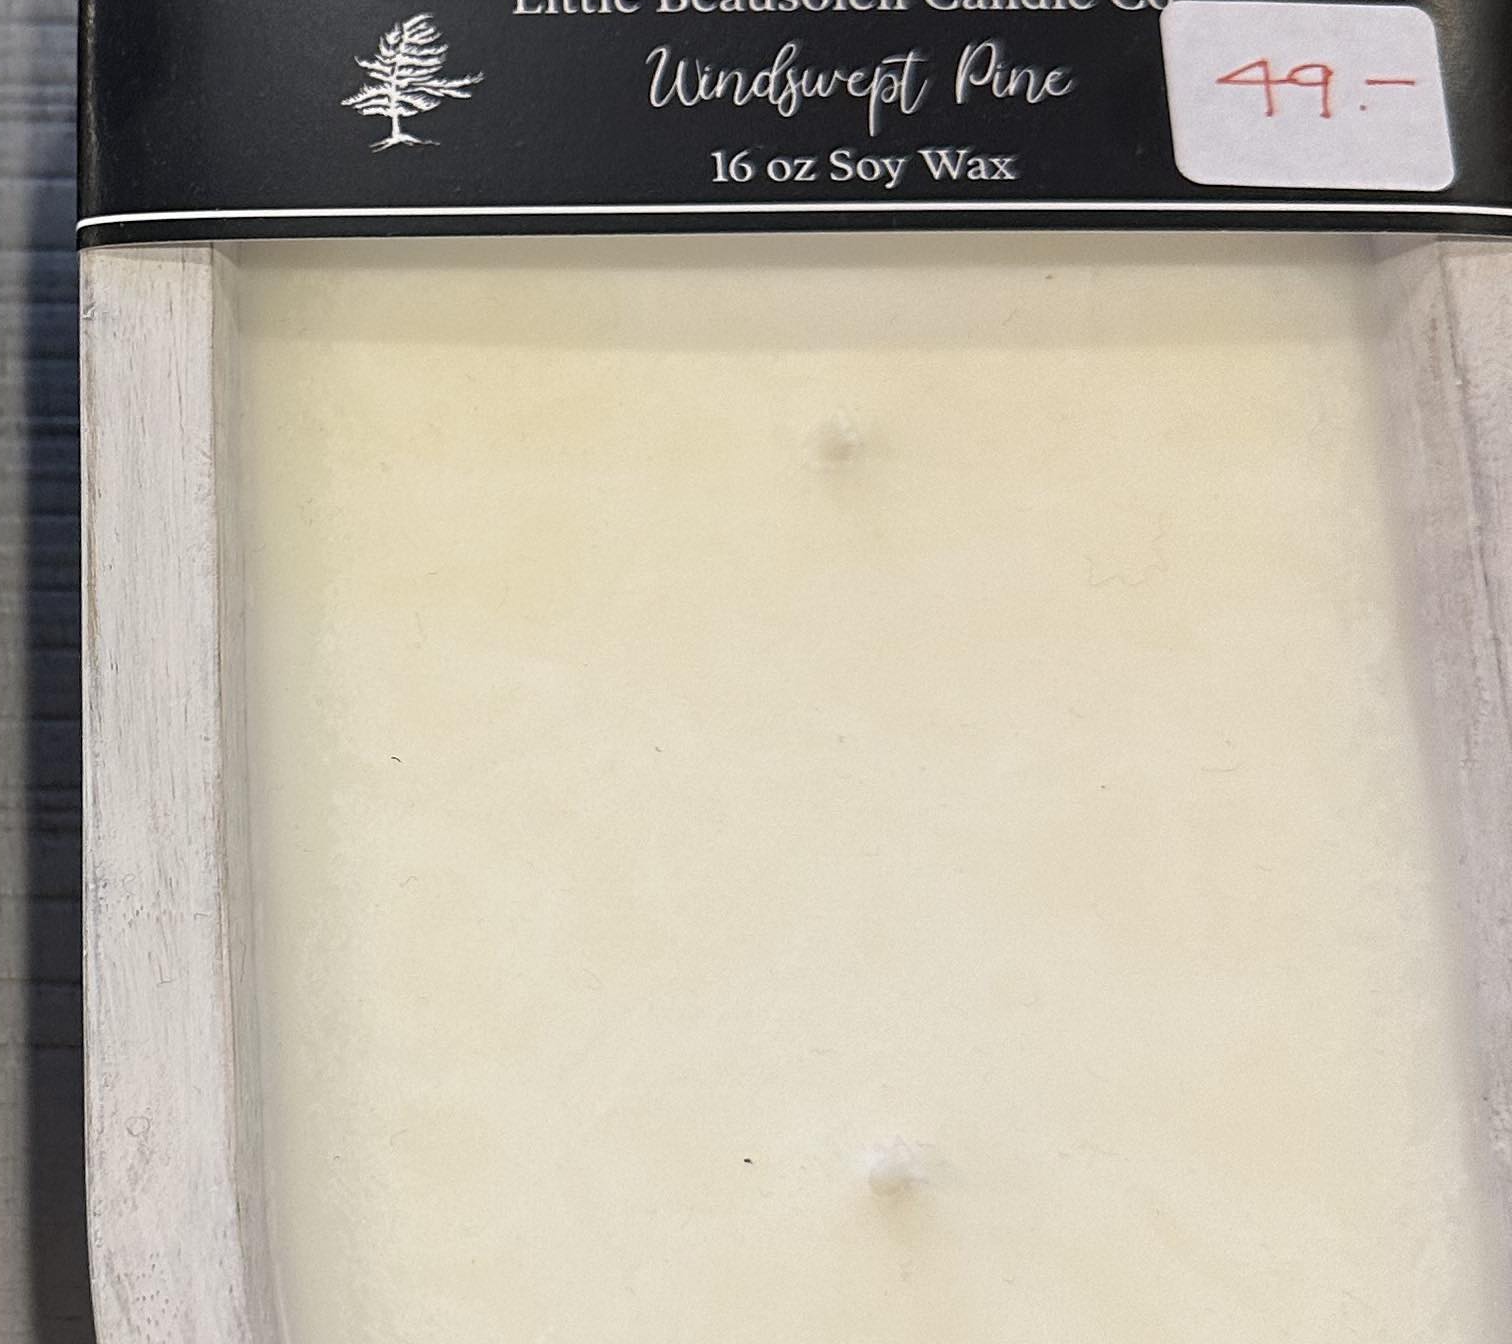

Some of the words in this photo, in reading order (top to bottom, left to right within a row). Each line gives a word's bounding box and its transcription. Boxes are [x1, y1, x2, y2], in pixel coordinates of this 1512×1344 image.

[645, 42, 929, 137] Windswept
[954, 40, 1075, 105] Pine
[711, 149, 755, 183] 16
[766, 158, 816, 182] oz
[829, 148, 907, 189] Soy
[917, 149, 1018, 181] Wax
